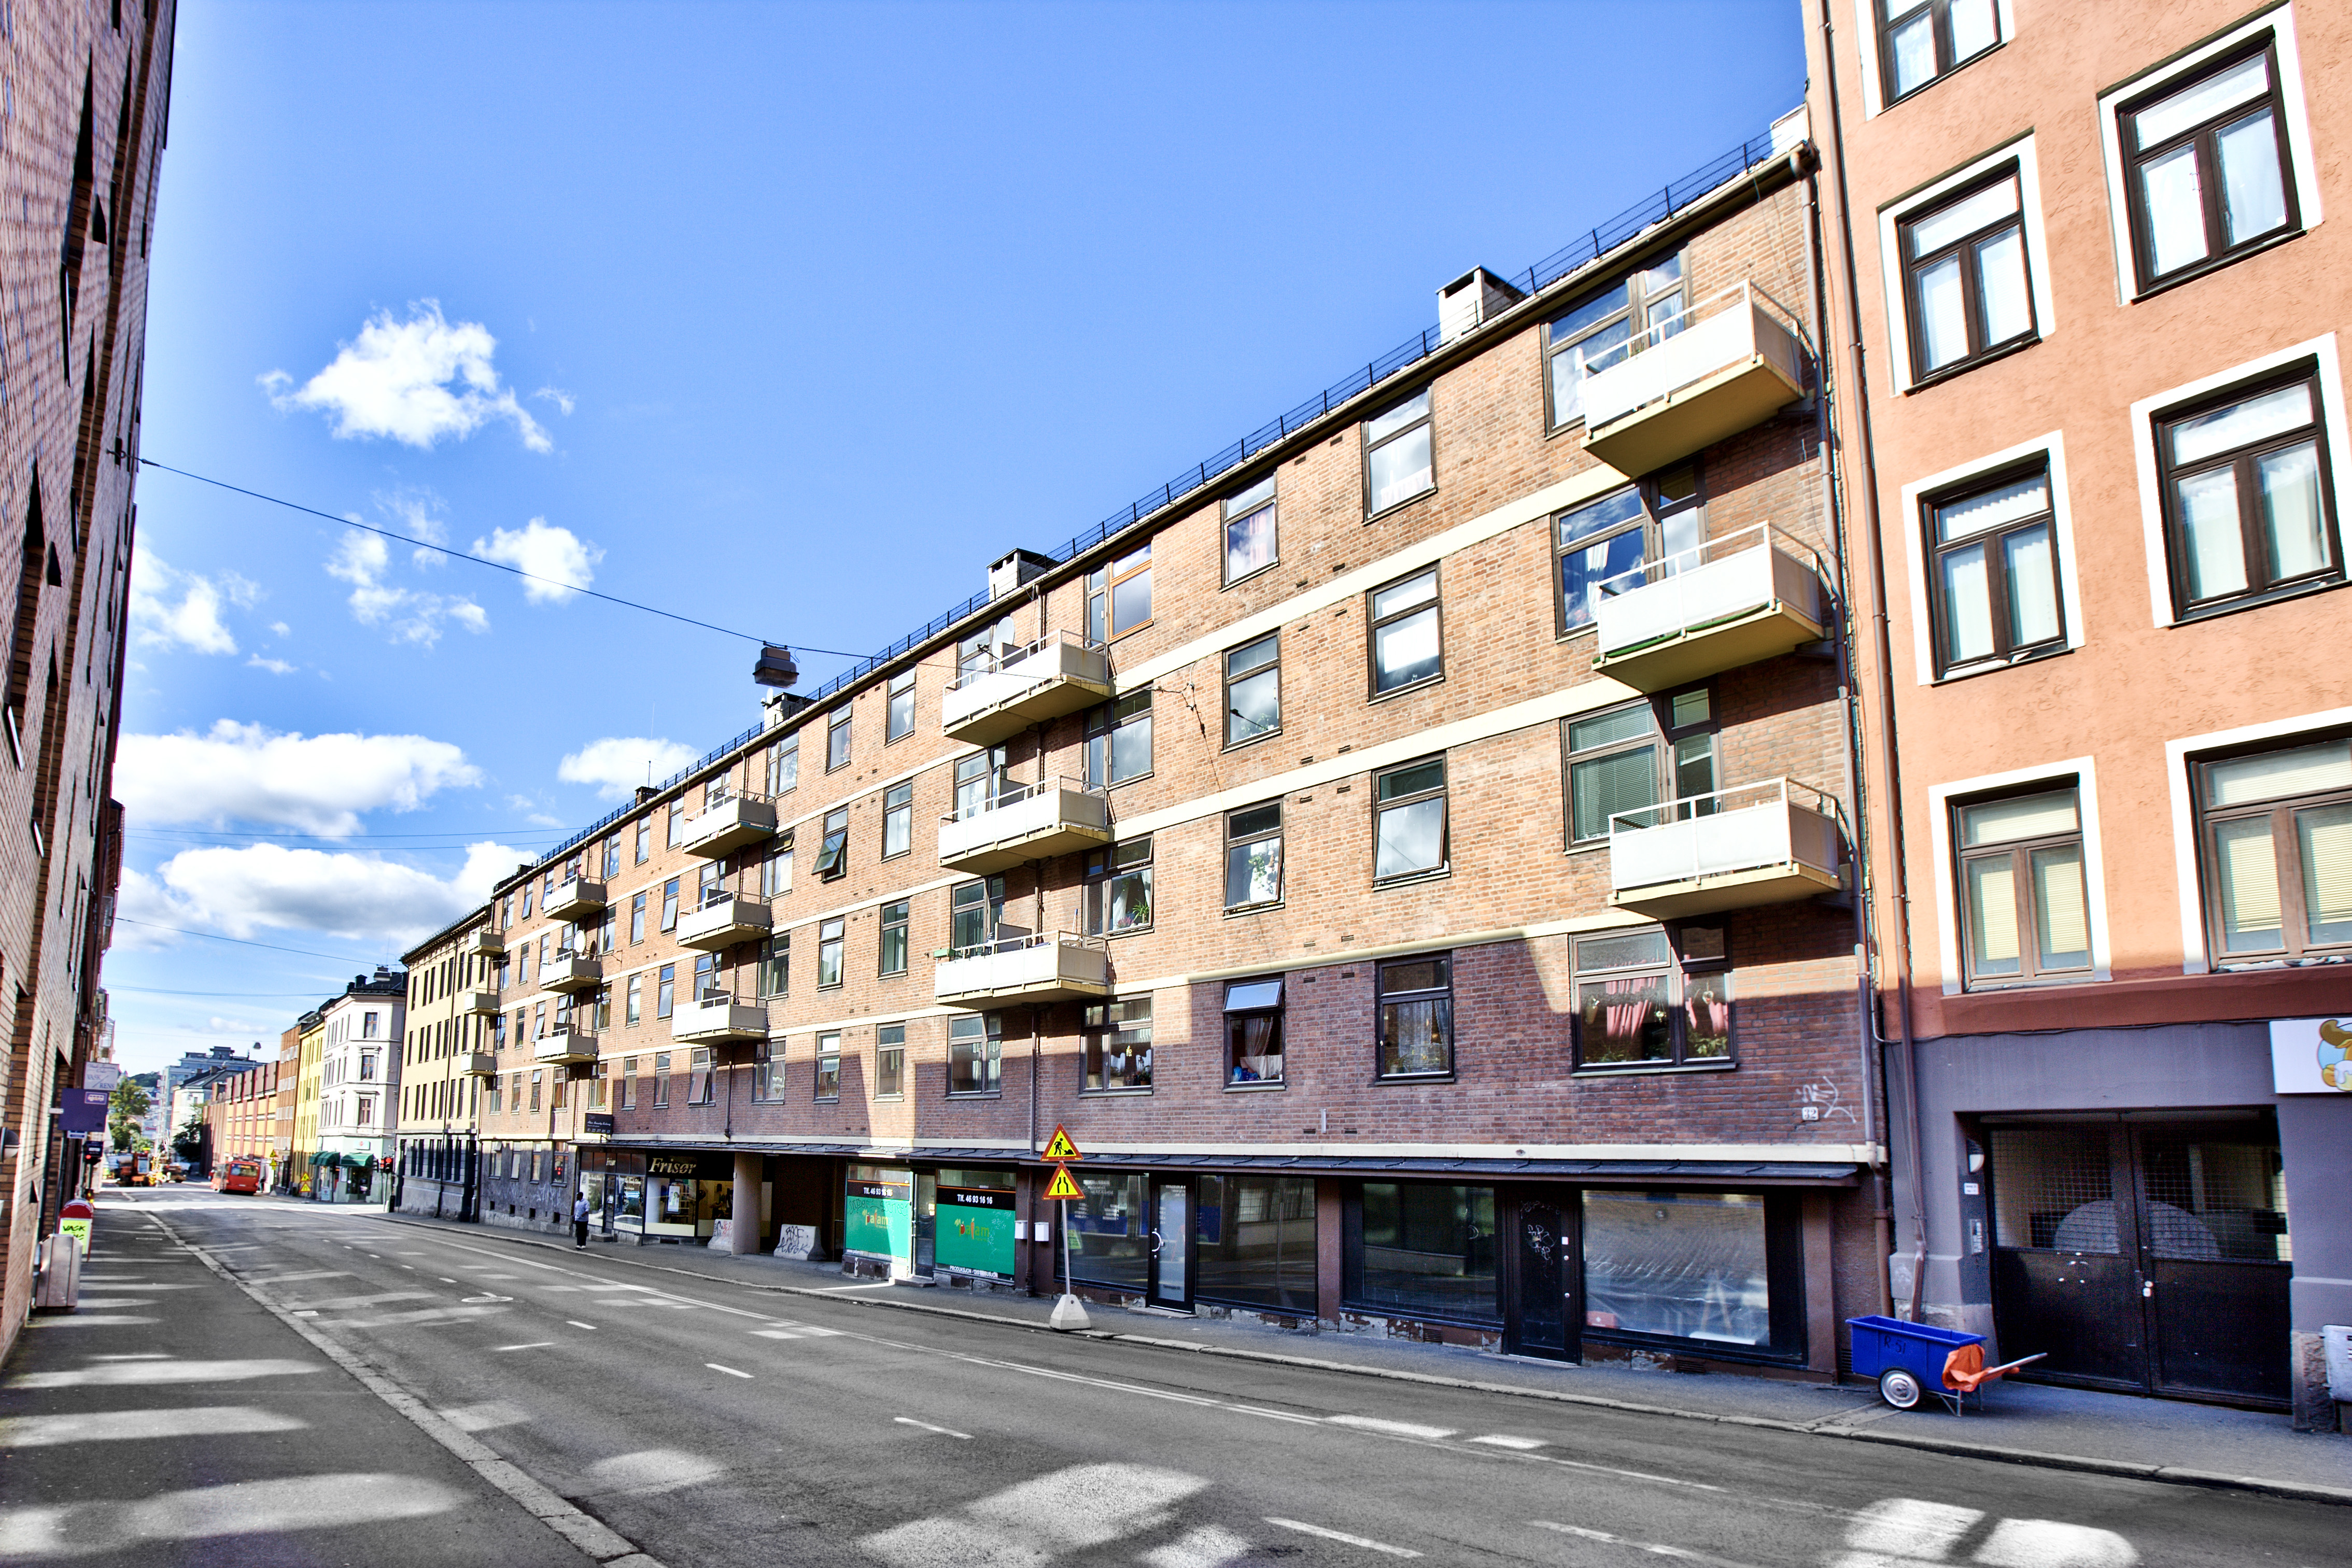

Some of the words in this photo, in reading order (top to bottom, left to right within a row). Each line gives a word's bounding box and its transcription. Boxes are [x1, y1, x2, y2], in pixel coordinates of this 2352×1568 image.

[1804, 1109, 1816, 1119] 32
[648, 1157, 697, 1174] Frisør
[979, 1196, 985, 1204] 16
[949, 1265, 972, 1274] PRODUKSJON
[1884, 1335, 1907, 1354] R-51
